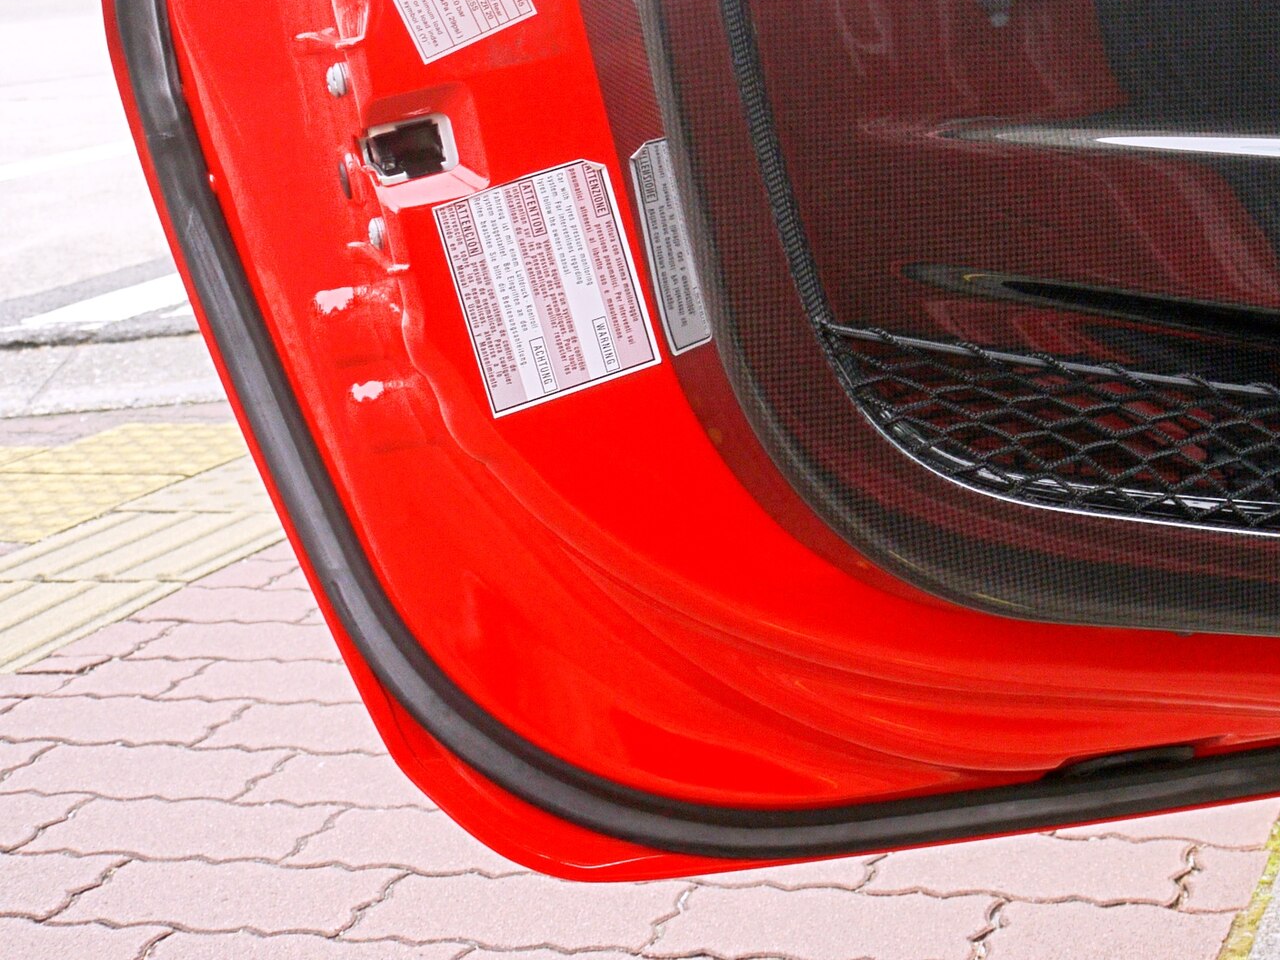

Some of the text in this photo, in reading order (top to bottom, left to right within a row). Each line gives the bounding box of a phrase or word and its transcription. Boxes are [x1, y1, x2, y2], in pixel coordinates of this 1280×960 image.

[521, 183, 543, 234] ATTENTION
[611, 243, 619, 255] con
[533, 344, 552, 385] ACHTUNG
[596, 322, 615, 365] WARNING
